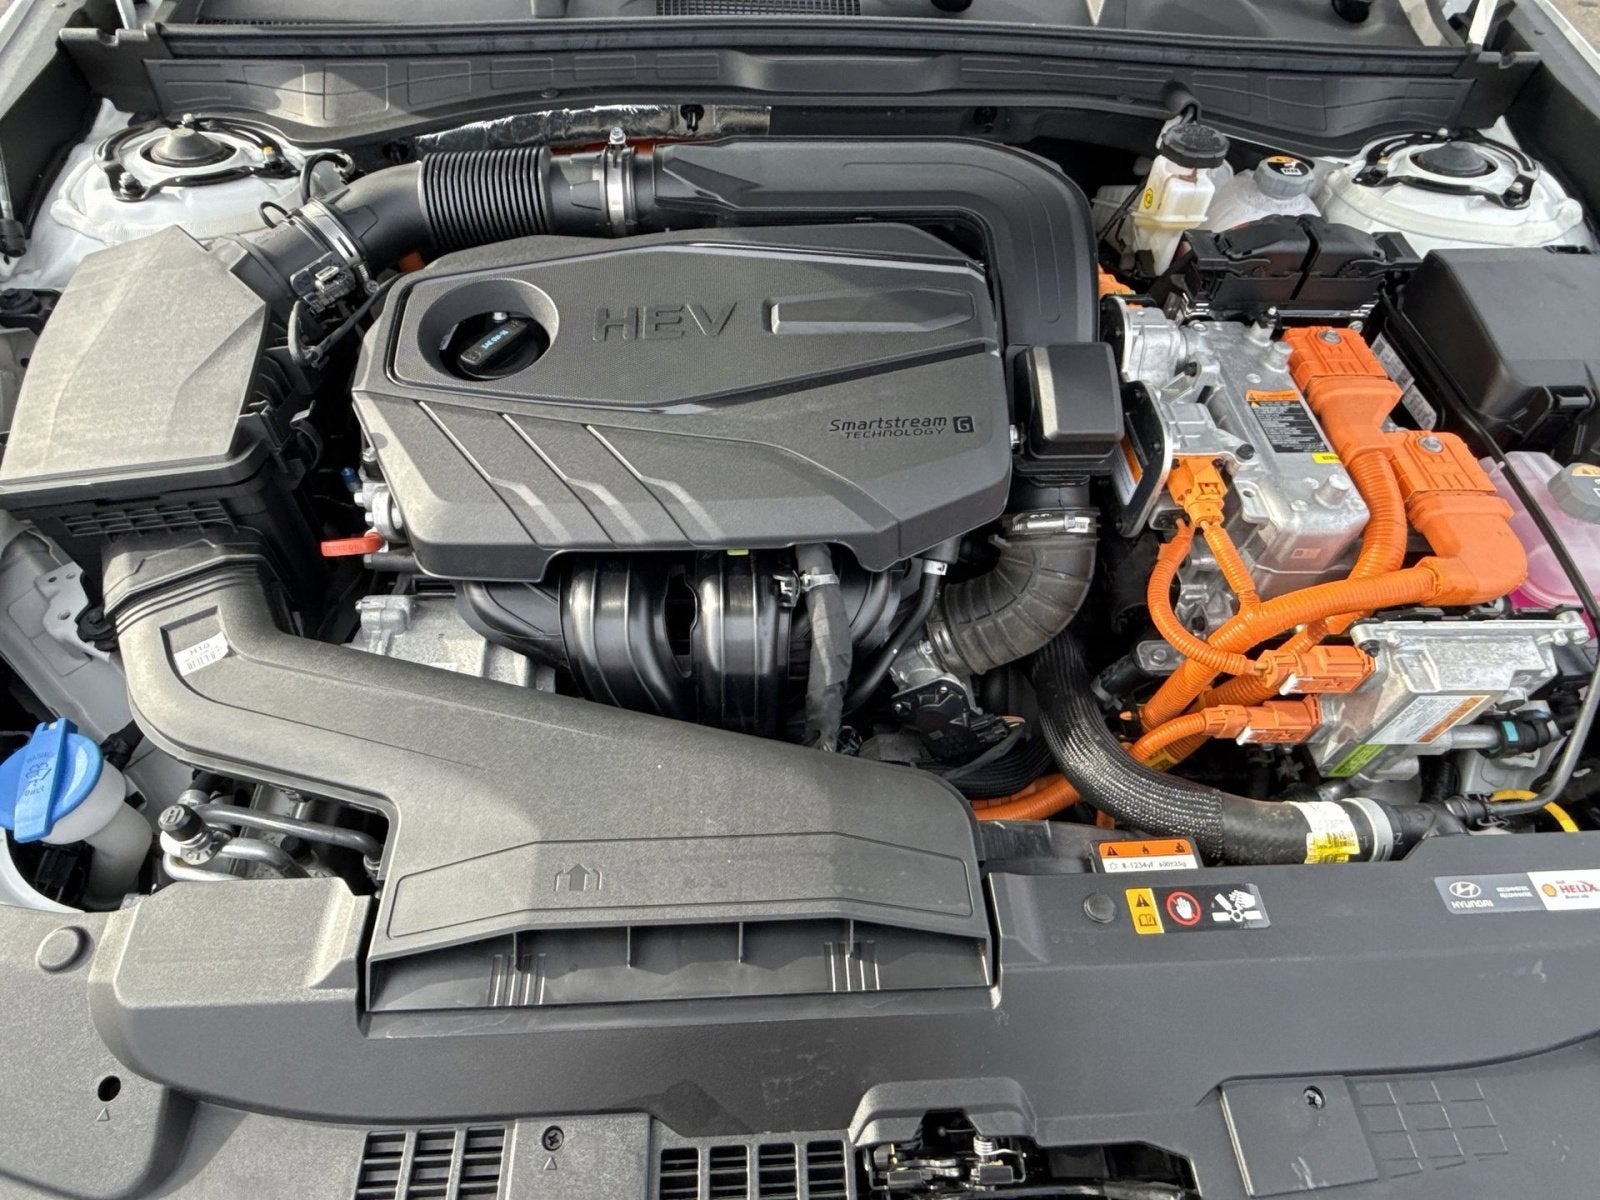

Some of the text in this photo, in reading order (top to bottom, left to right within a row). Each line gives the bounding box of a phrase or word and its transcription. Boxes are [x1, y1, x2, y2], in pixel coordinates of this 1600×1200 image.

[592, 302, 738, 341] HEV
[829, 416, 973, 433] Smartstream G
[844, 427, 946, 439] TECHNOLOGY
[1451, 899, 1495, 909] HYUNDAI
